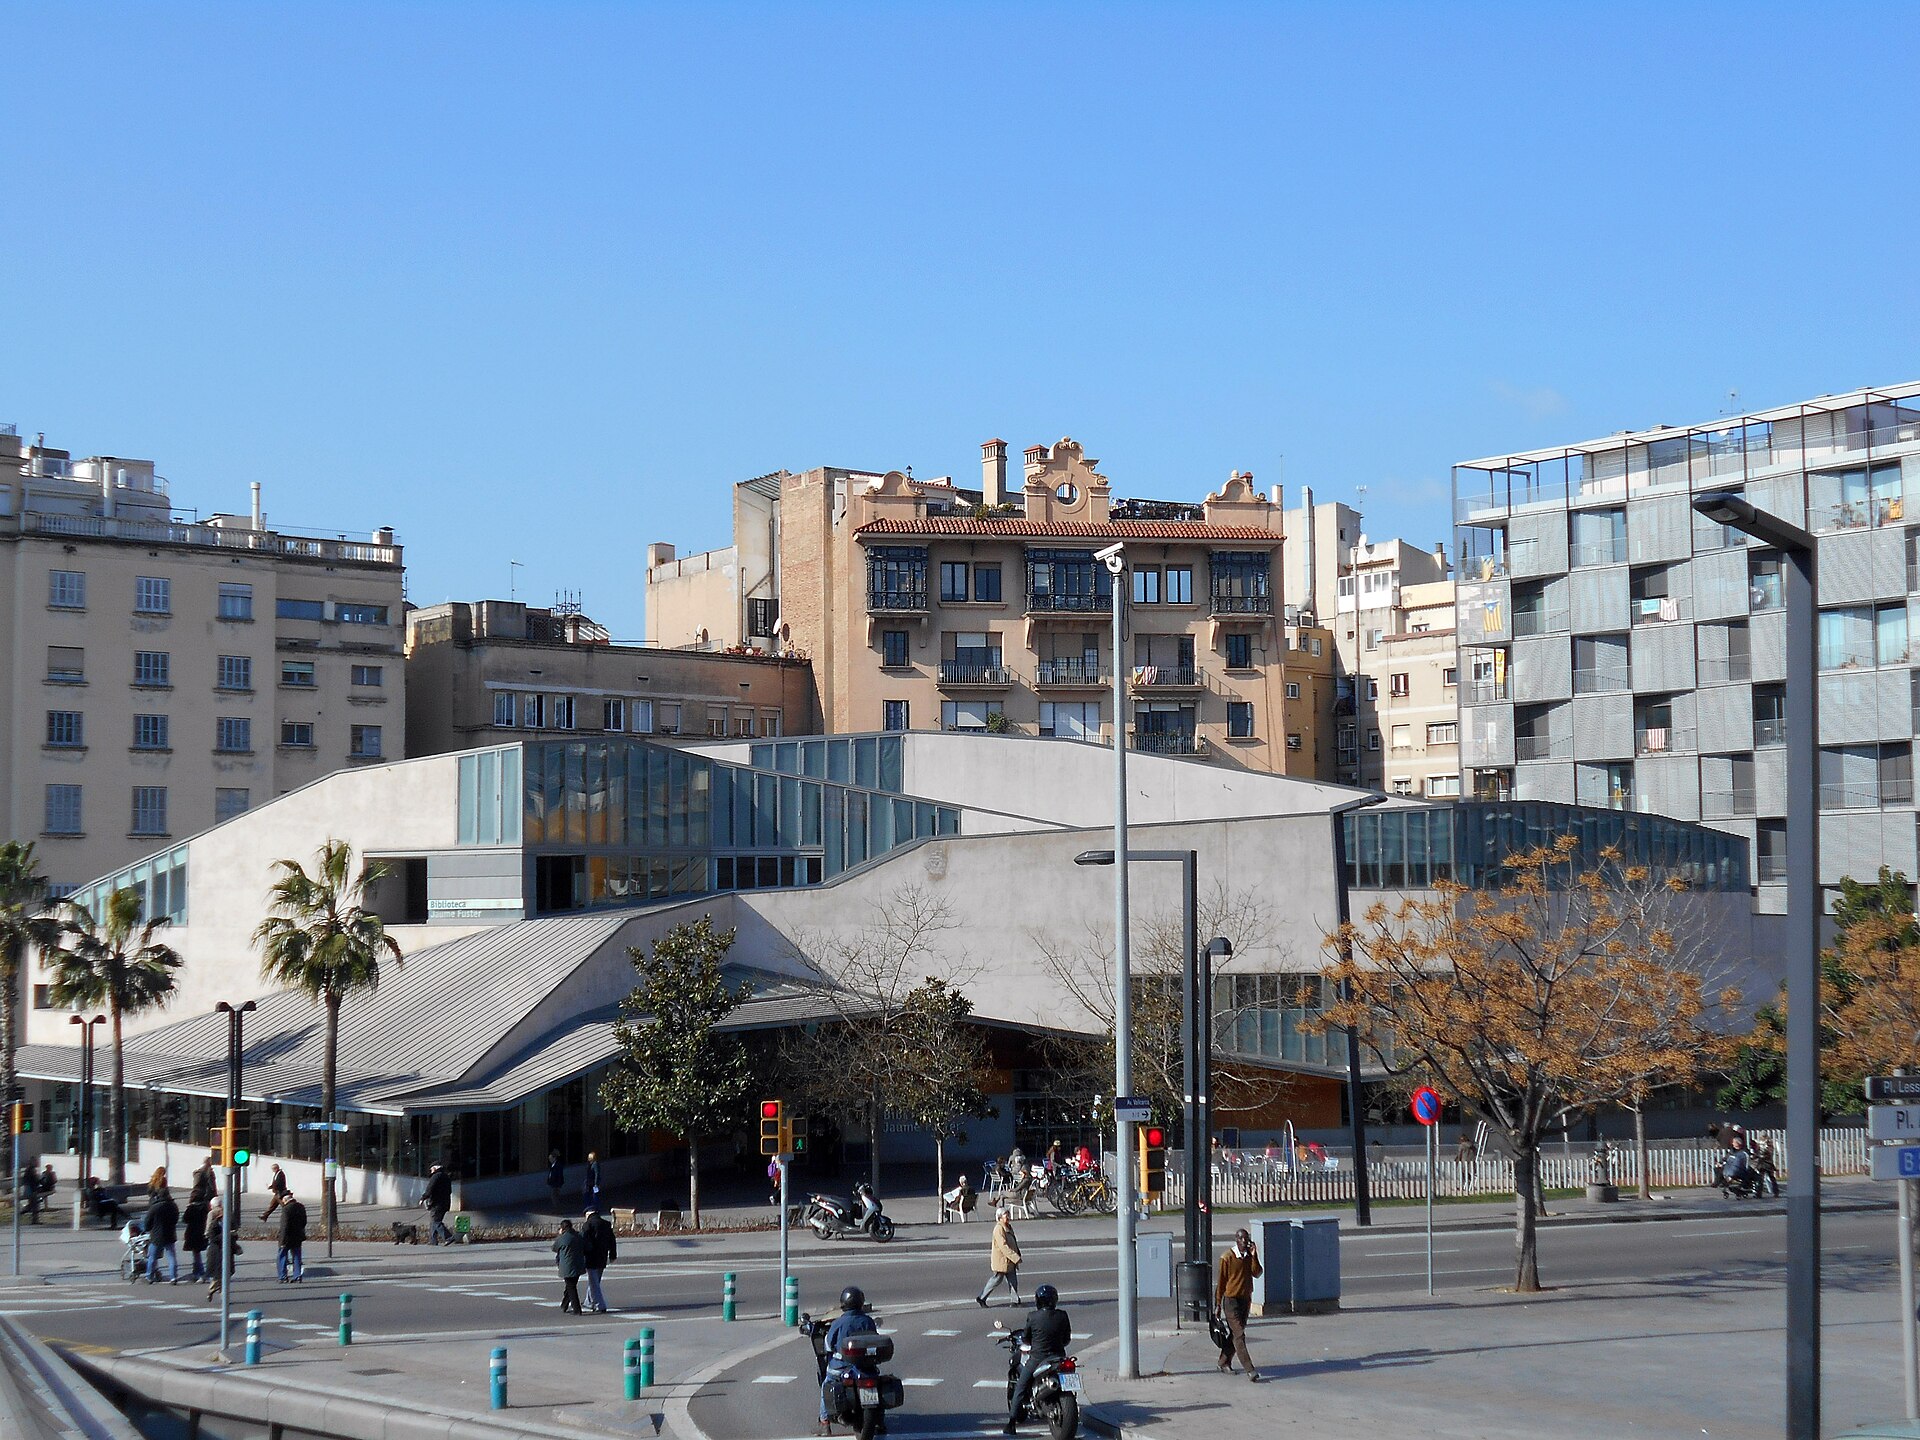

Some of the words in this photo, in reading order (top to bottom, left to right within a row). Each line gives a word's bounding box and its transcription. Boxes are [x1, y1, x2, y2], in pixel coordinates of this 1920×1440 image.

[430, 900, 466, 908] Biblioteca
[430, 910, 455, 918] Jaume
[457, 910, 482, 918] Fuster
[1883, 1080, 1896, 1094] Pl.
[1896, 1110, 1914, 1130] Pl.
